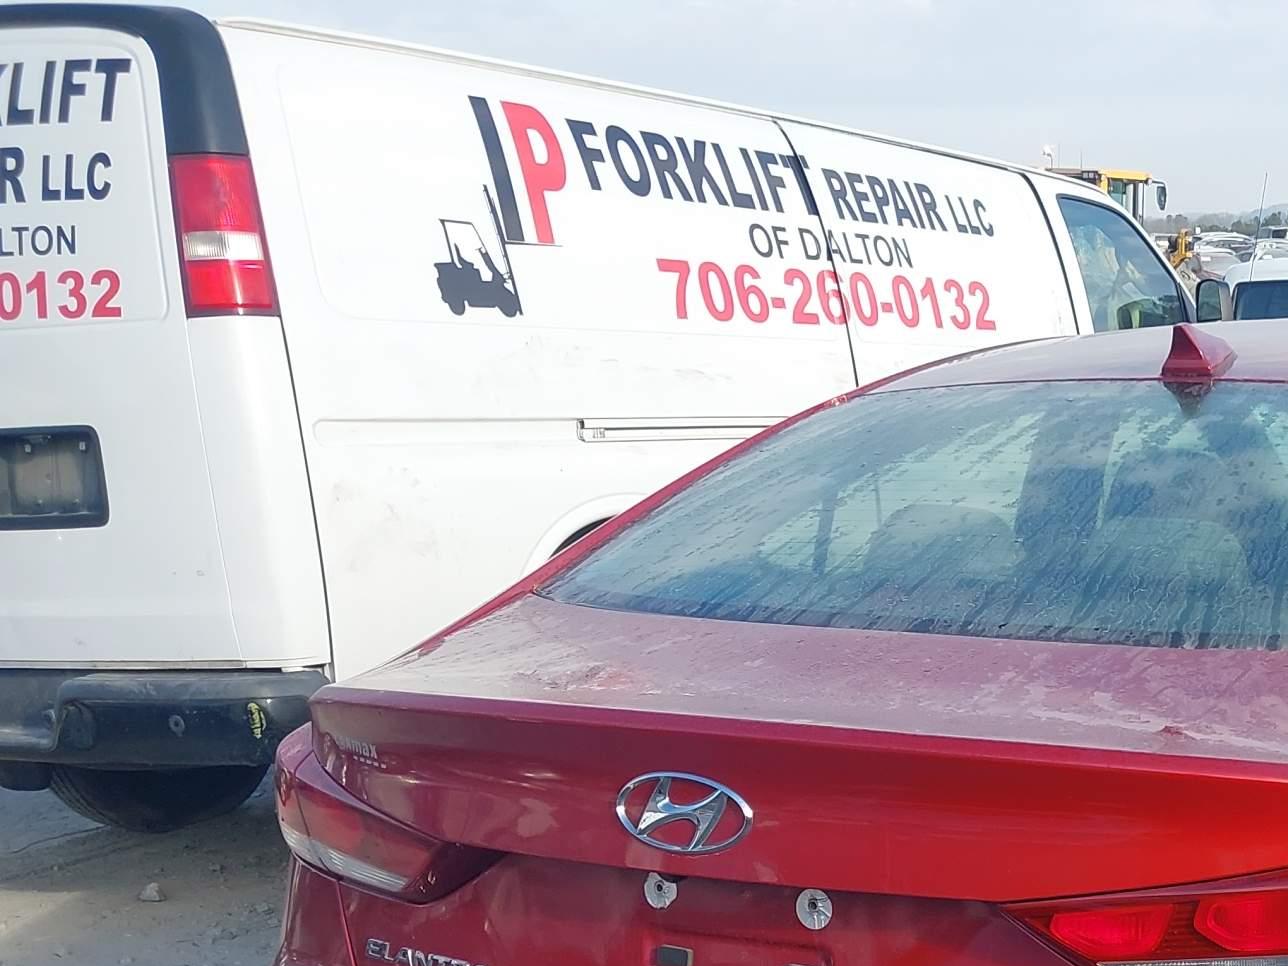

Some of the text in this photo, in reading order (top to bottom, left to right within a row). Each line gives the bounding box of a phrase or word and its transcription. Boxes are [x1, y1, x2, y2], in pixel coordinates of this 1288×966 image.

[0, 58, 132, 127] LIFT
[41, 152, 112, 201] LLC
[565, 118, 995, 238] FORKLIFT REPAIR LLC
[748, 223, 914, 269] OF DALTON
[655, 258, 997, 331] 706-260-0132
